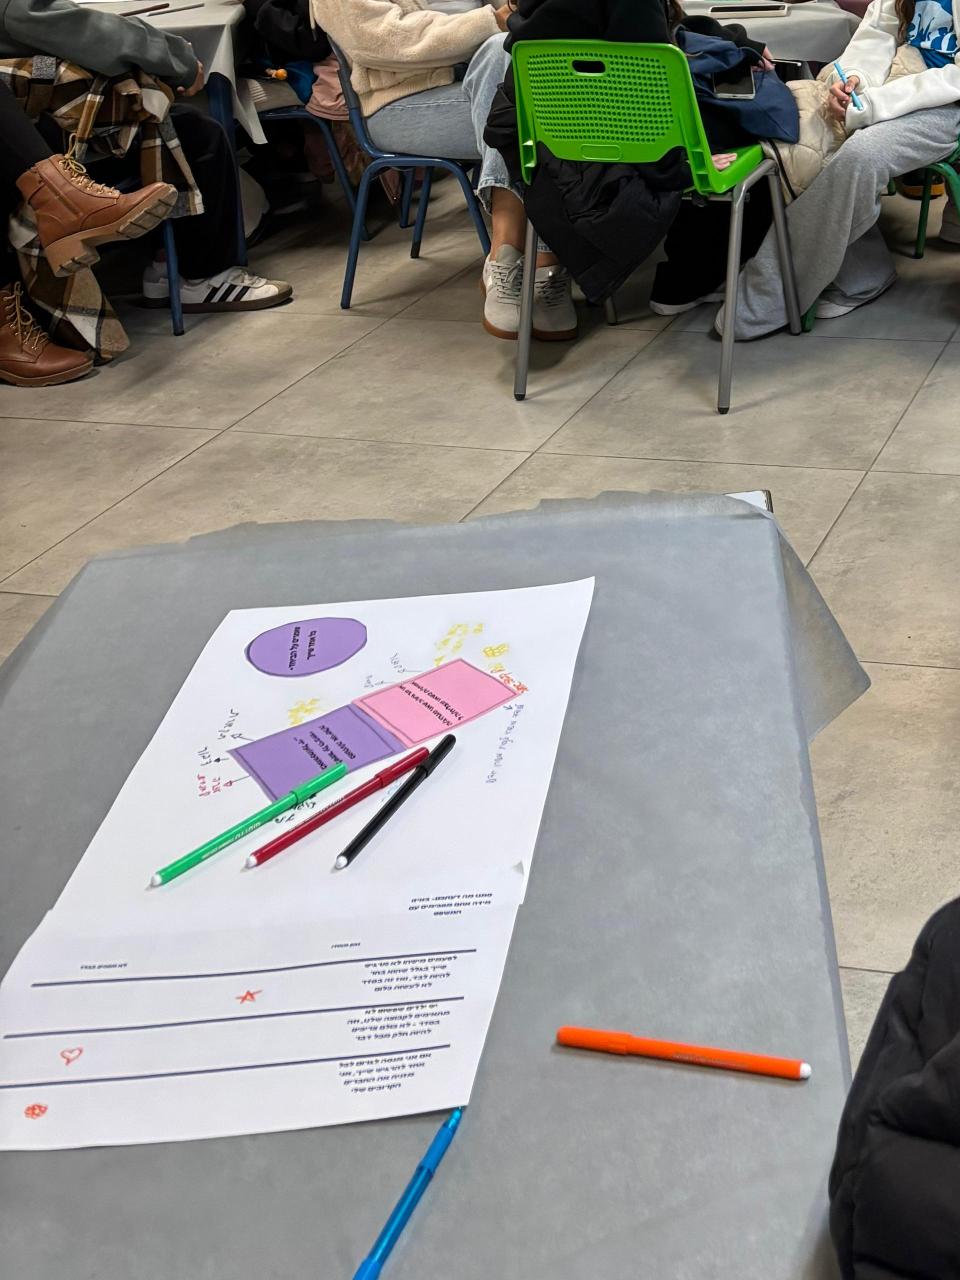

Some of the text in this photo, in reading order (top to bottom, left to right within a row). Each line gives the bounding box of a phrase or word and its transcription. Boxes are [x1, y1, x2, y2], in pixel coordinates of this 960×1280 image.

[293, 626, 301, 643] שומרים
[289, 643, 299, 651] על
[308, 637, 316, 648] אחד
[306, 648, 316, 660] שייך
